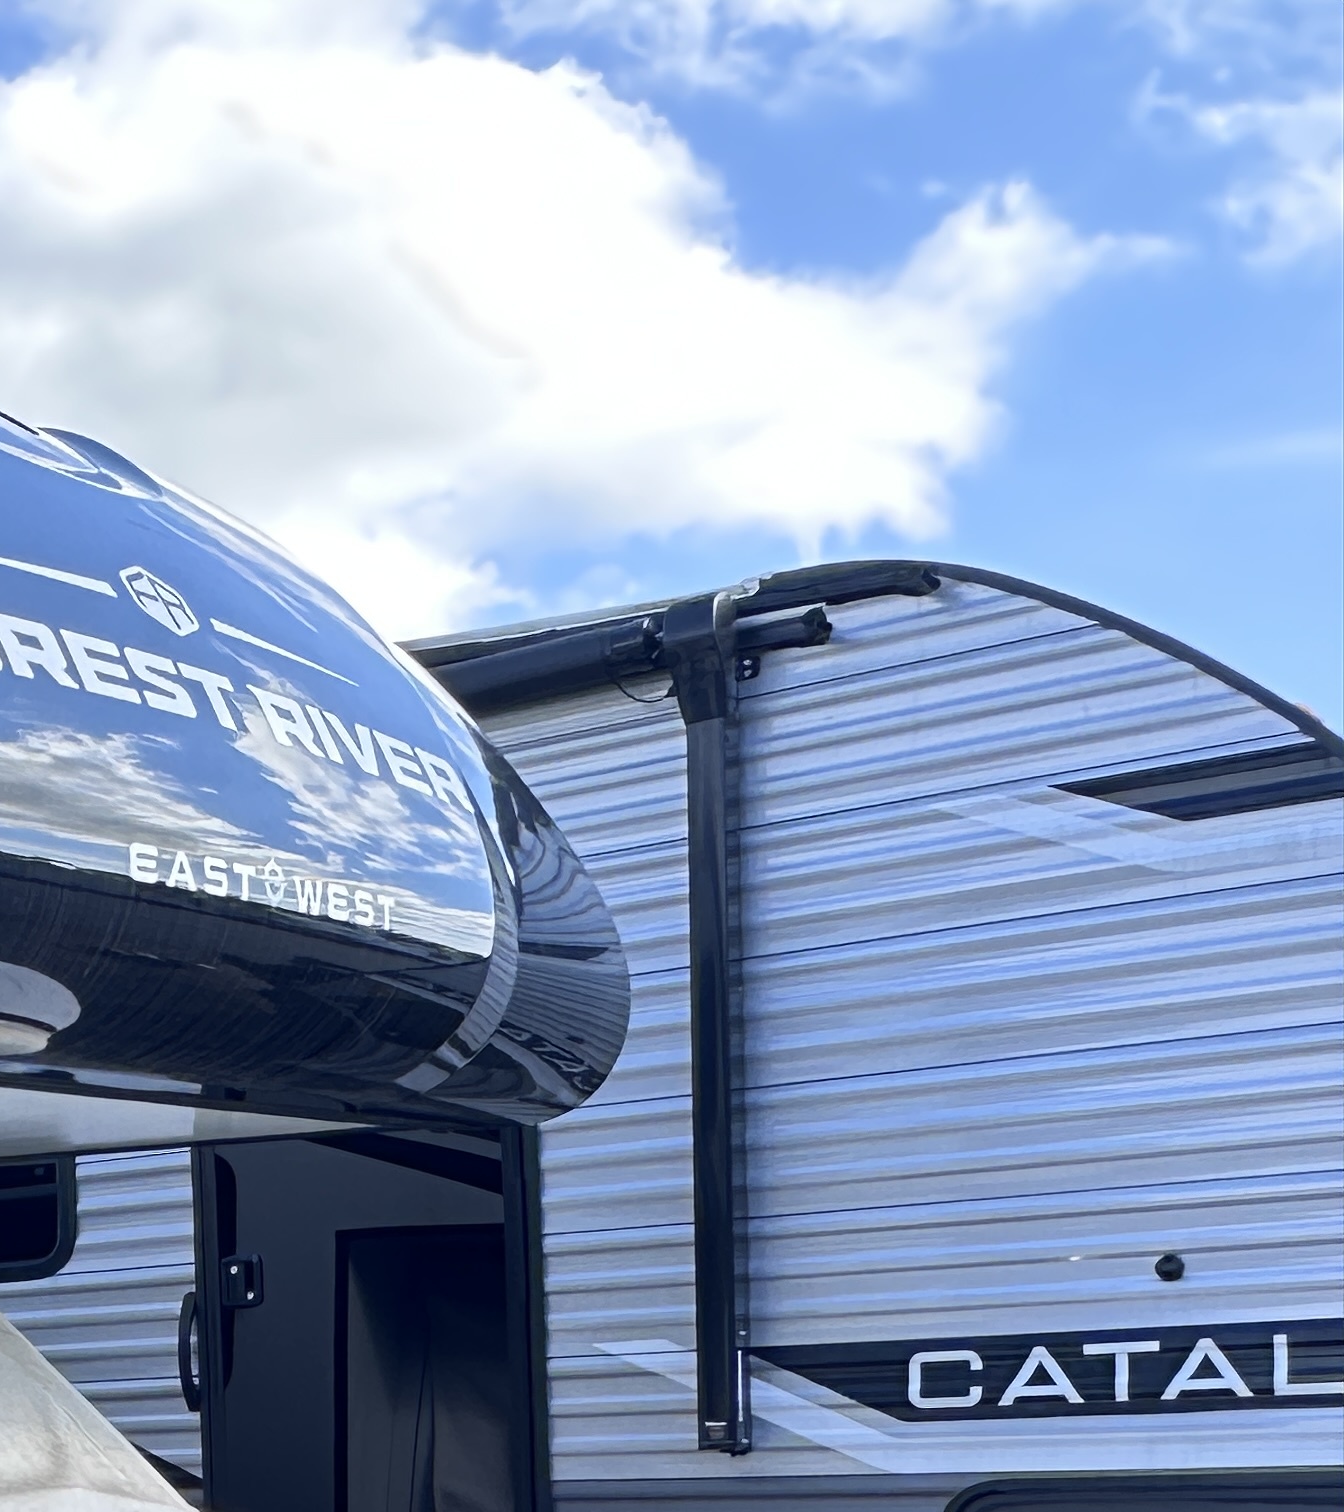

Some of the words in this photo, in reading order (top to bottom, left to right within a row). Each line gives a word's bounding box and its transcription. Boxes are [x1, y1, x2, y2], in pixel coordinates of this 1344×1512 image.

[247, 685, 475, 812] RIVER
[129, 842, 256, 901] EAST
[292, 875, 396, 930] WEST
[908, 1333, 1344, 1410] CATAL
